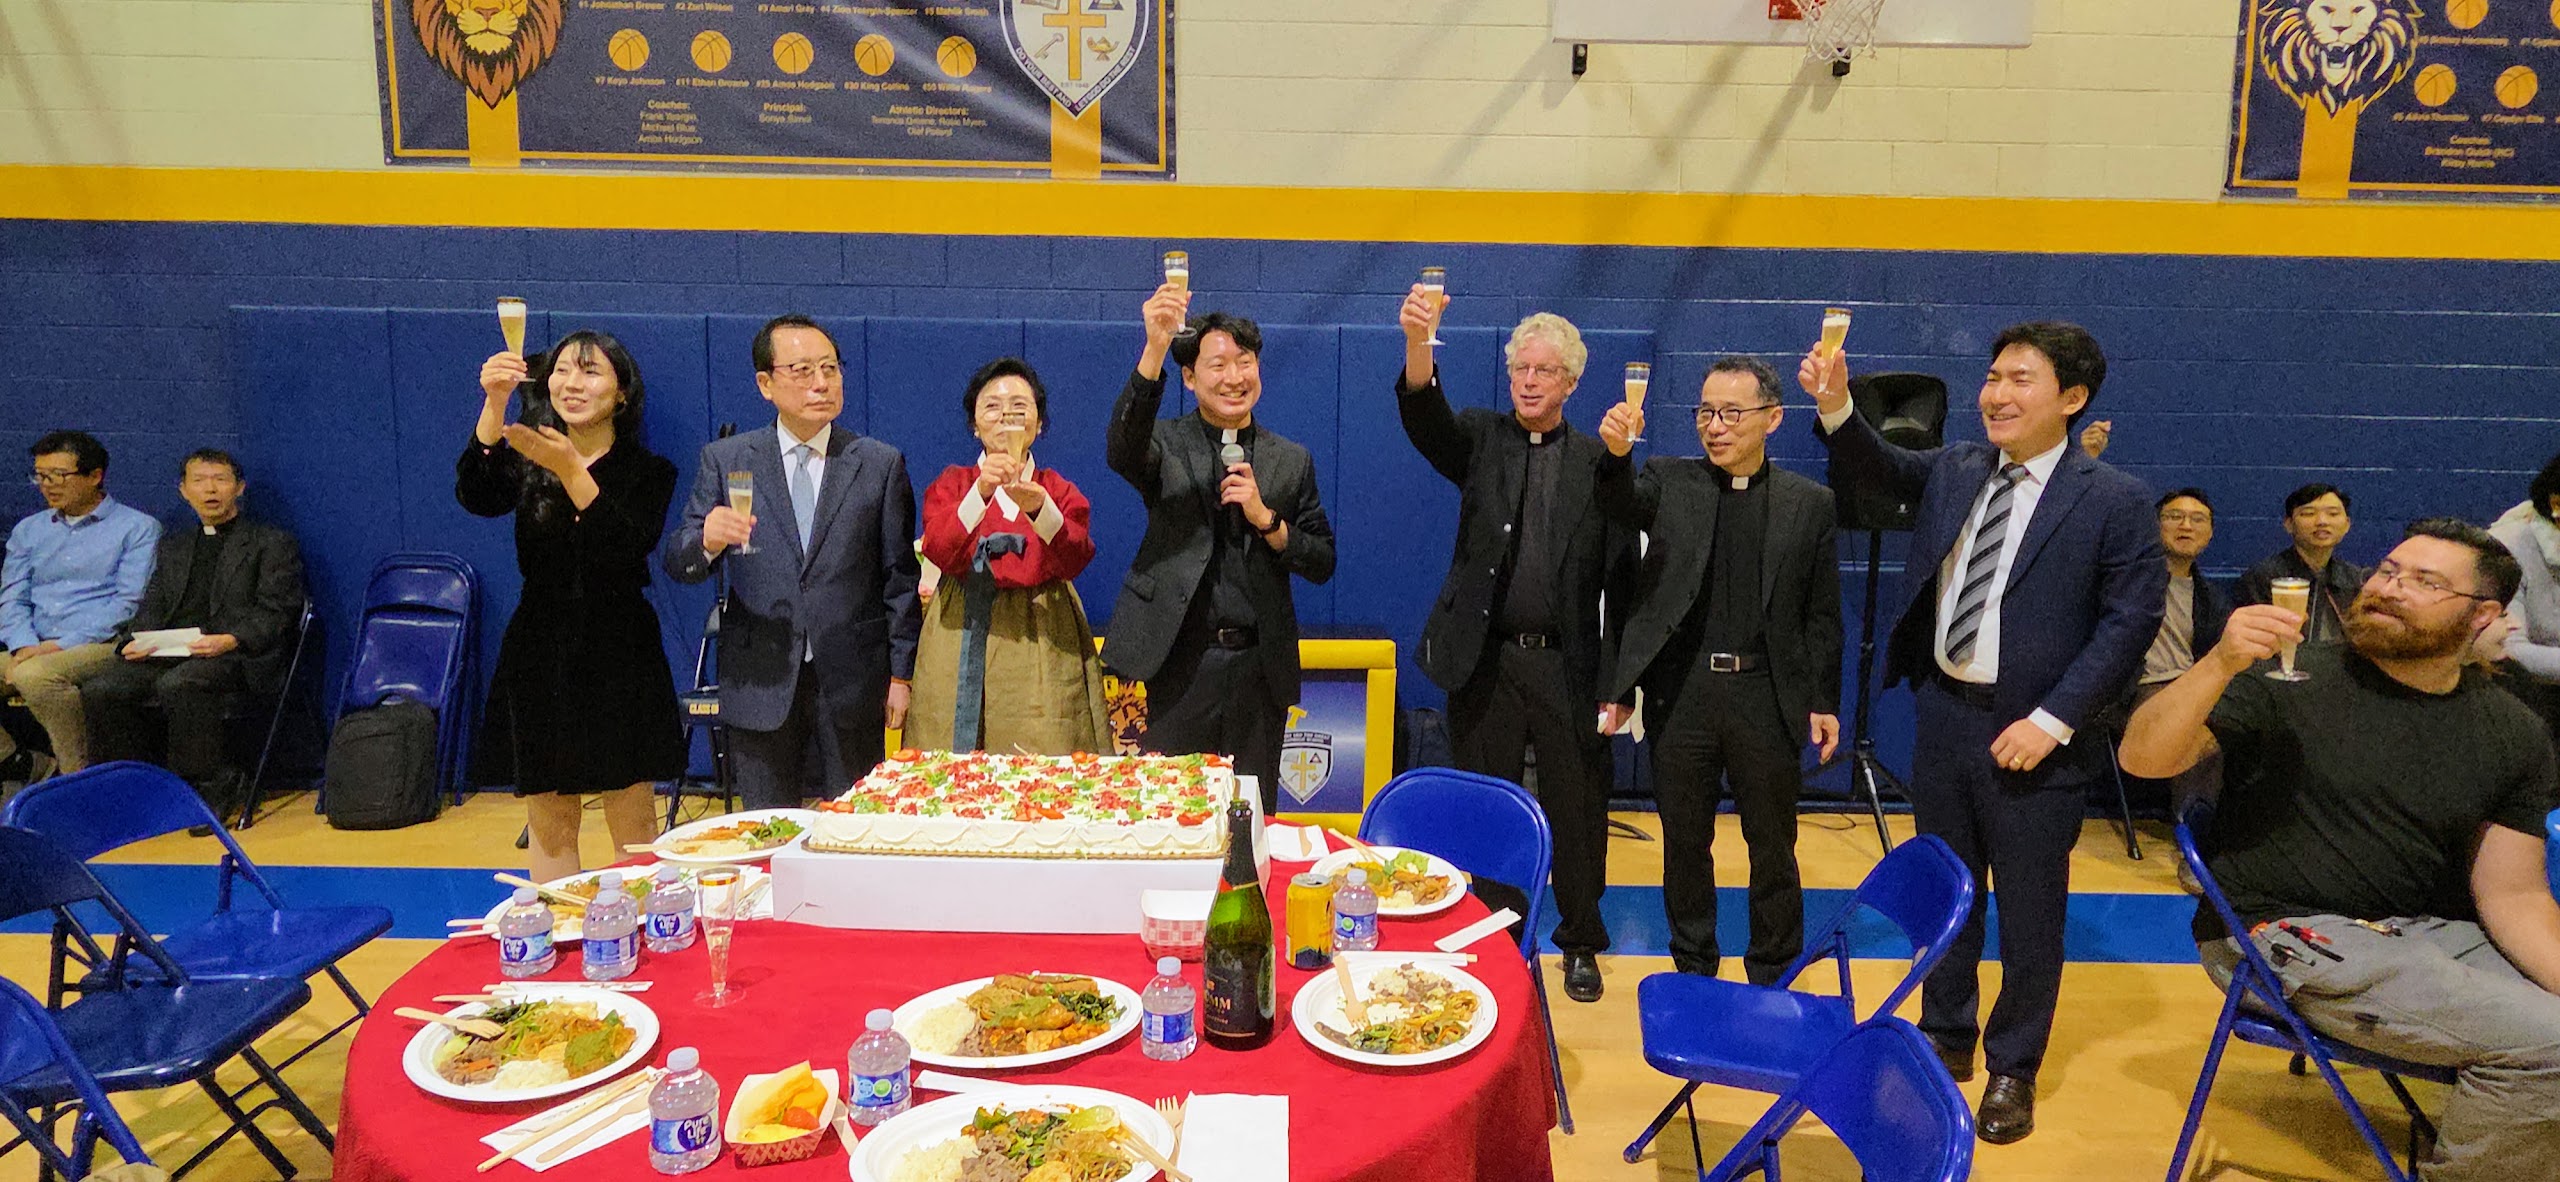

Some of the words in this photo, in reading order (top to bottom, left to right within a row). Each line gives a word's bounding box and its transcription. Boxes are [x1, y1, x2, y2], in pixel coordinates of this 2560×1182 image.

[1015, 46, 1027, 60] DO
[1023, 57, 1044, 80] YOUR
[1039, 75, 1059, 95] BEST
[1055, 91, 1072, 108] AND
[763, 102, 807, 114] Principal:
[925, 105, 970, 117] Directors:
